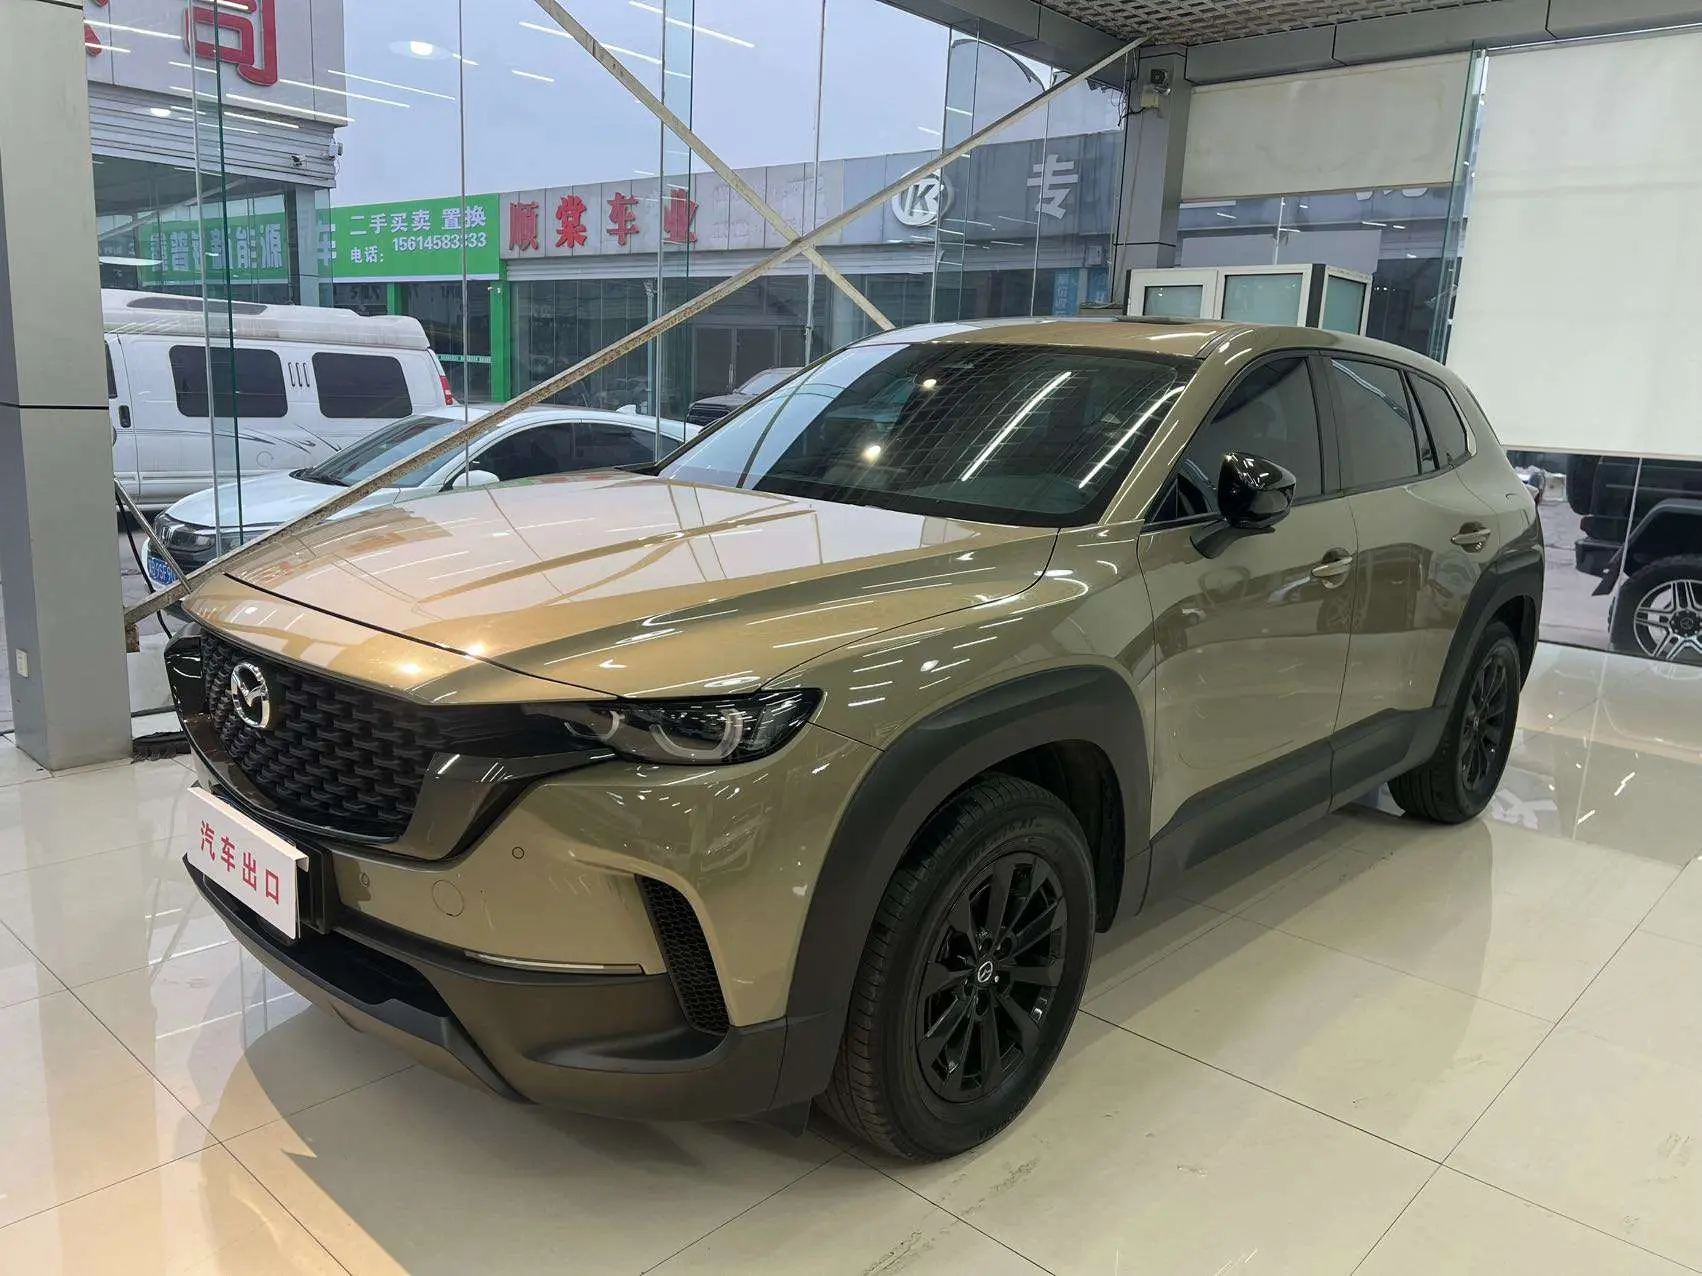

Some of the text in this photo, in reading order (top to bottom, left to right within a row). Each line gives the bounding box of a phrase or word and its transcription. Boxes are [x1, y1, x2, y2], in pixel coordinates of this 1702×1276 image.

[350, 205, 487, 235] 二手买卖 置换
[200, 820, 279, 905] 汽车出口
